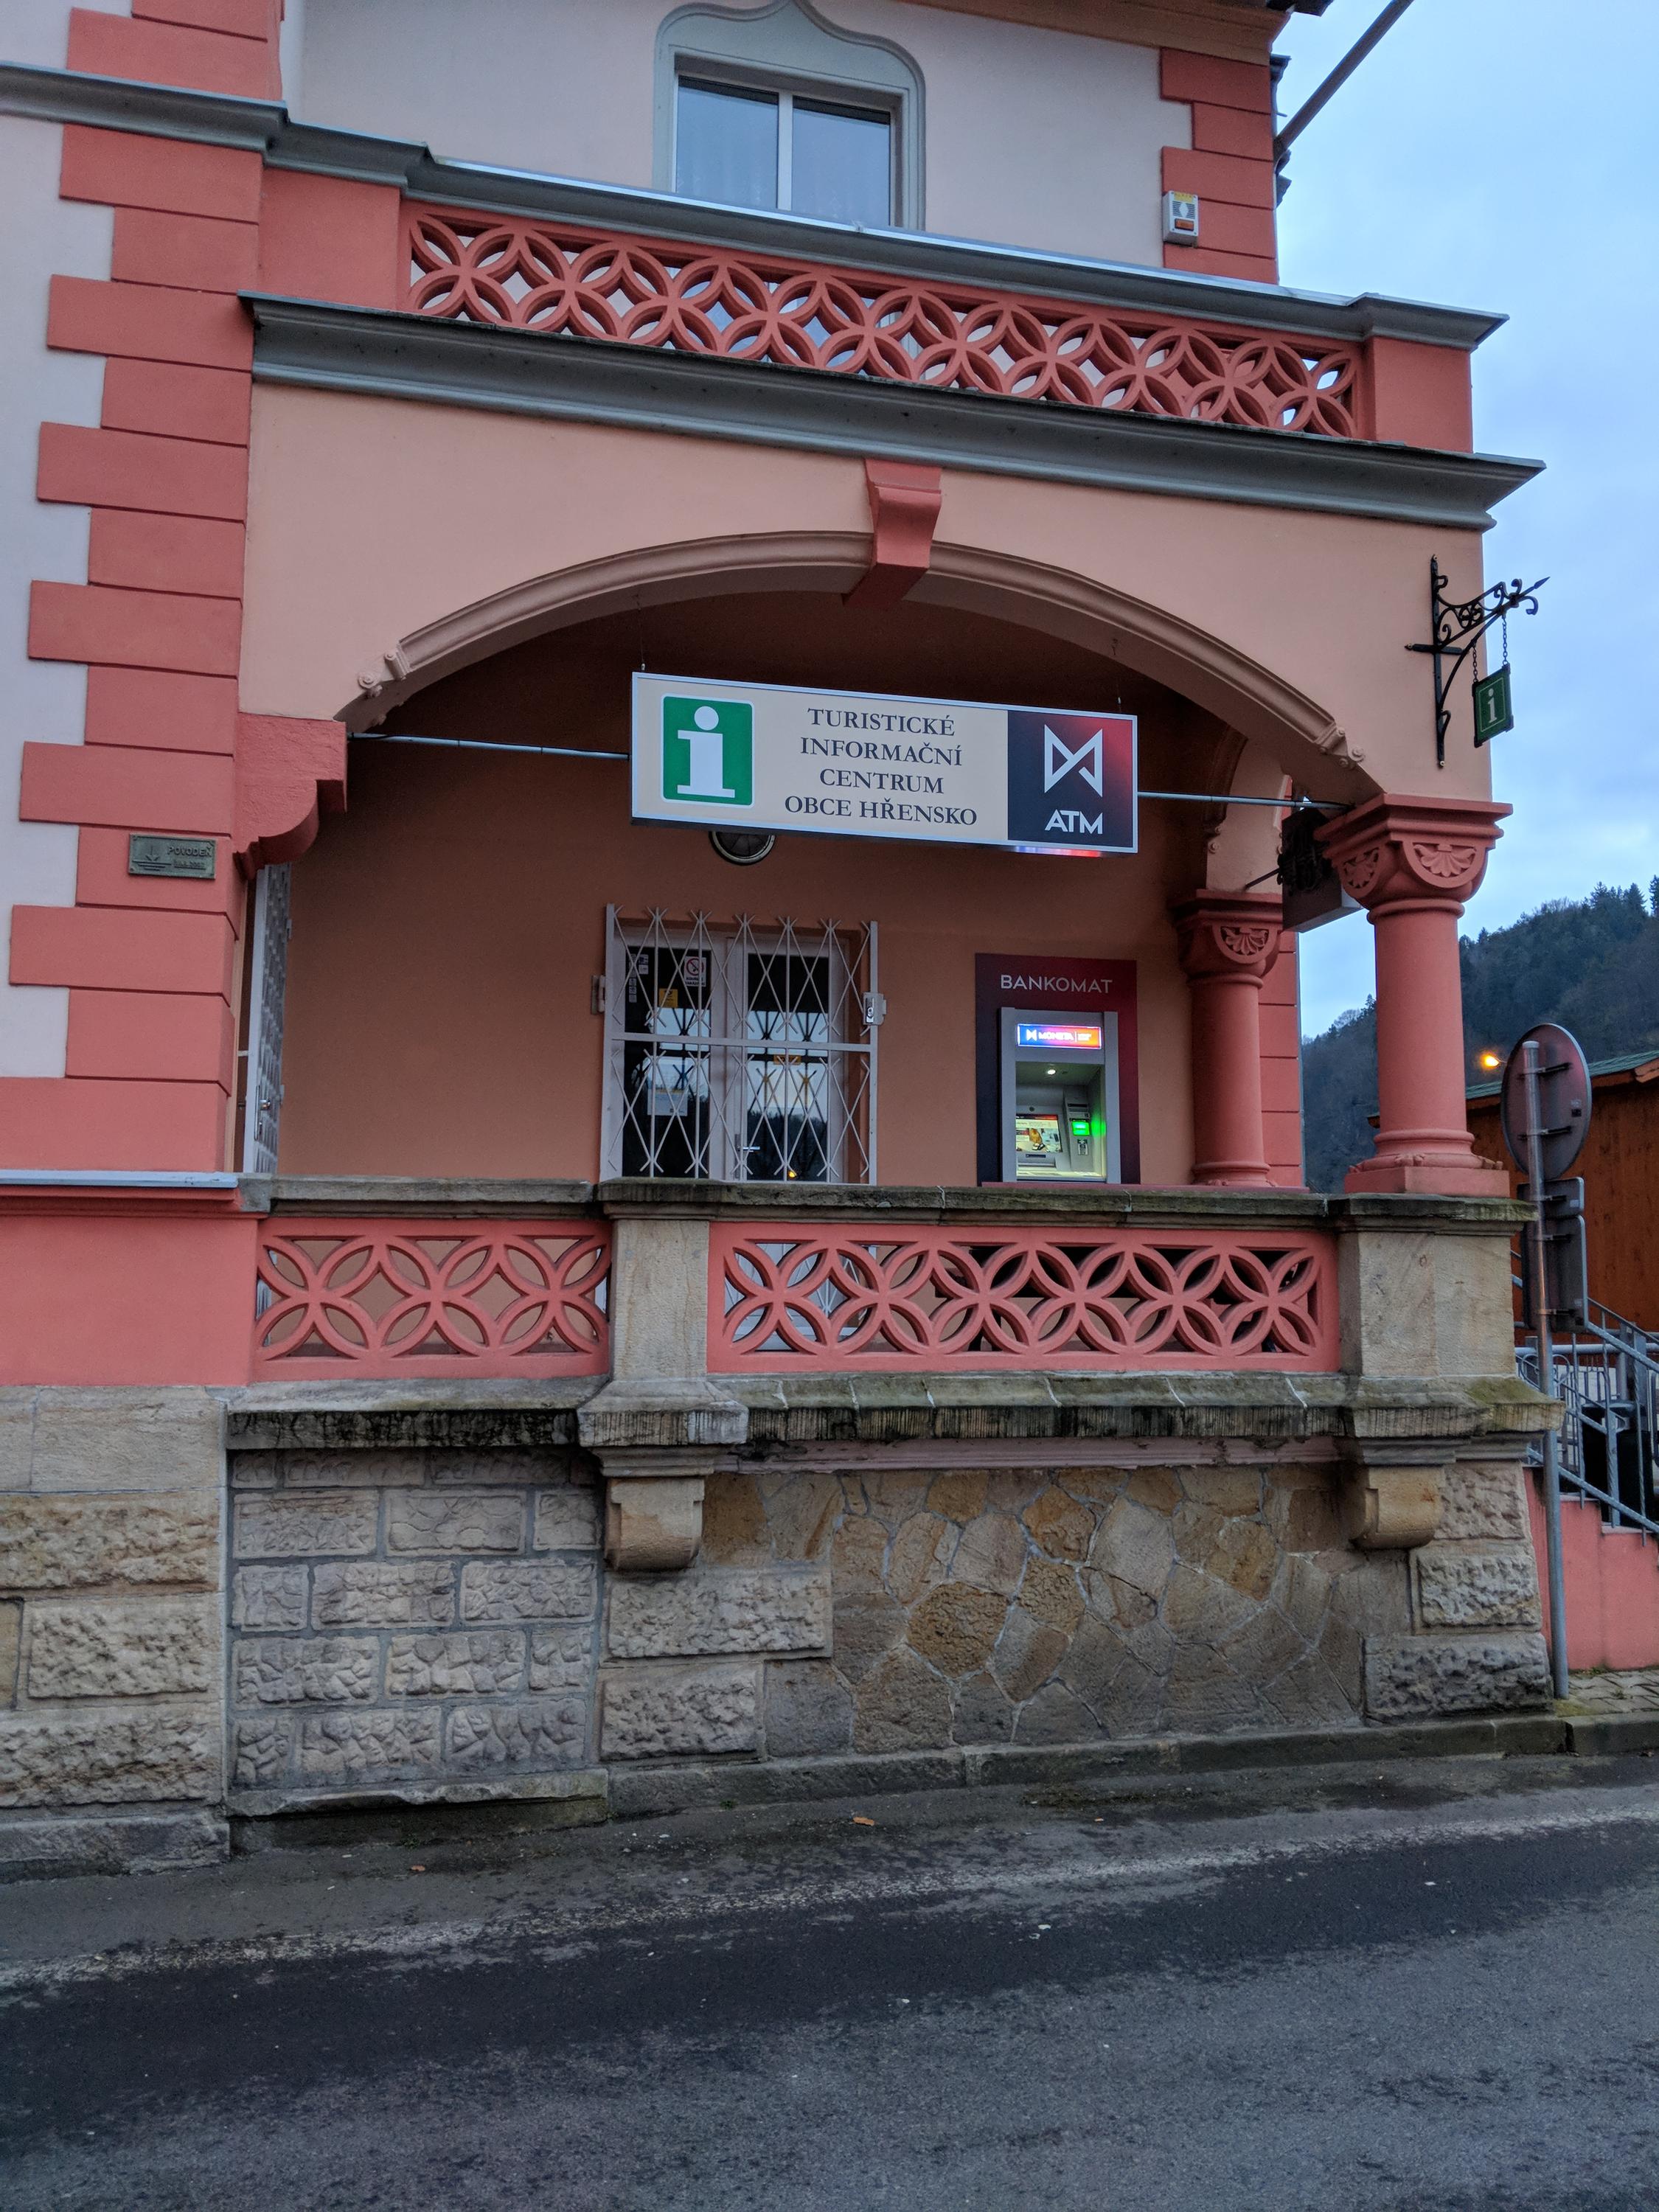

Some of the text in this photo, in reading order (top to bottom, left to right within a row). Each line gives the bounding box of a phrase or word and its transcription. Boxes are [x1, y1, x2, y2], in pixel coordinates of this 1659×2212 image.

[807, 706, 955, 737] TURISTICKÉ
[800, 737, 963, 767] INFORMAČNÍ
[819, 768, 943, 795] CENTRUM
[785, 794, 977, 827] OBCE HŘENSKO
[1044, 809, 1103, 835] ATM
[1000, 974, 1113, 994] BANKOMAT
